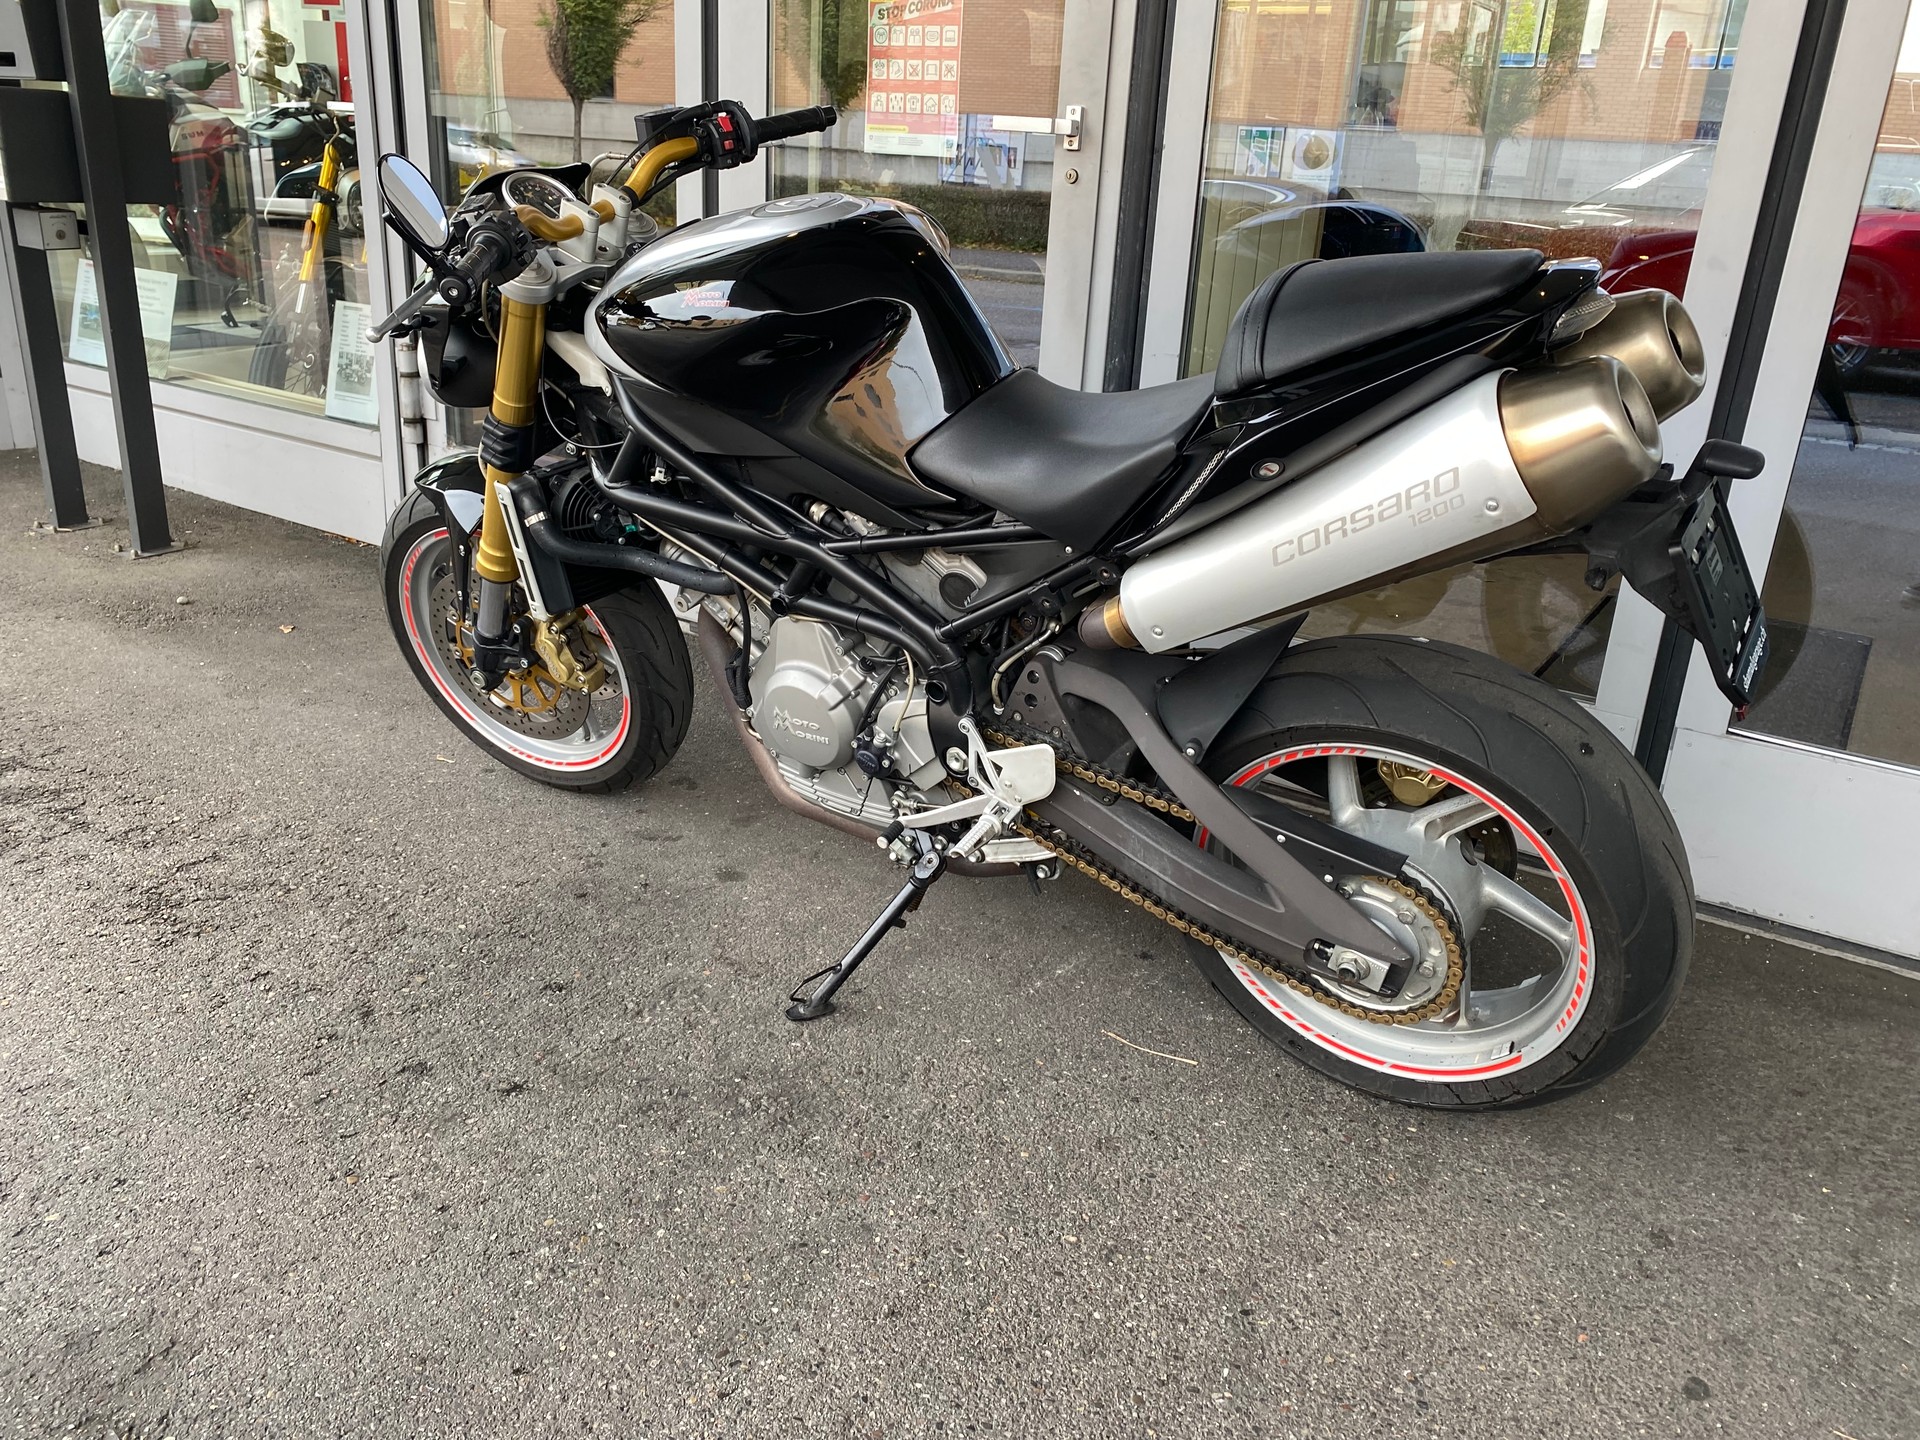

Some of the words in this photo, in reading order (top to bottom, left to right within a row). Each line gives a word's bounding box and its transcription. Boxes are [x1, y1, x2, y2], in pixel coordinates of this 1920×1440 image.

[878, 4, 907, 20] STOP
[1408, 493, 1465, 527] 1200
[773, 717, 829, 745] MORINI
[774, 706, 820, 730] MOTO
